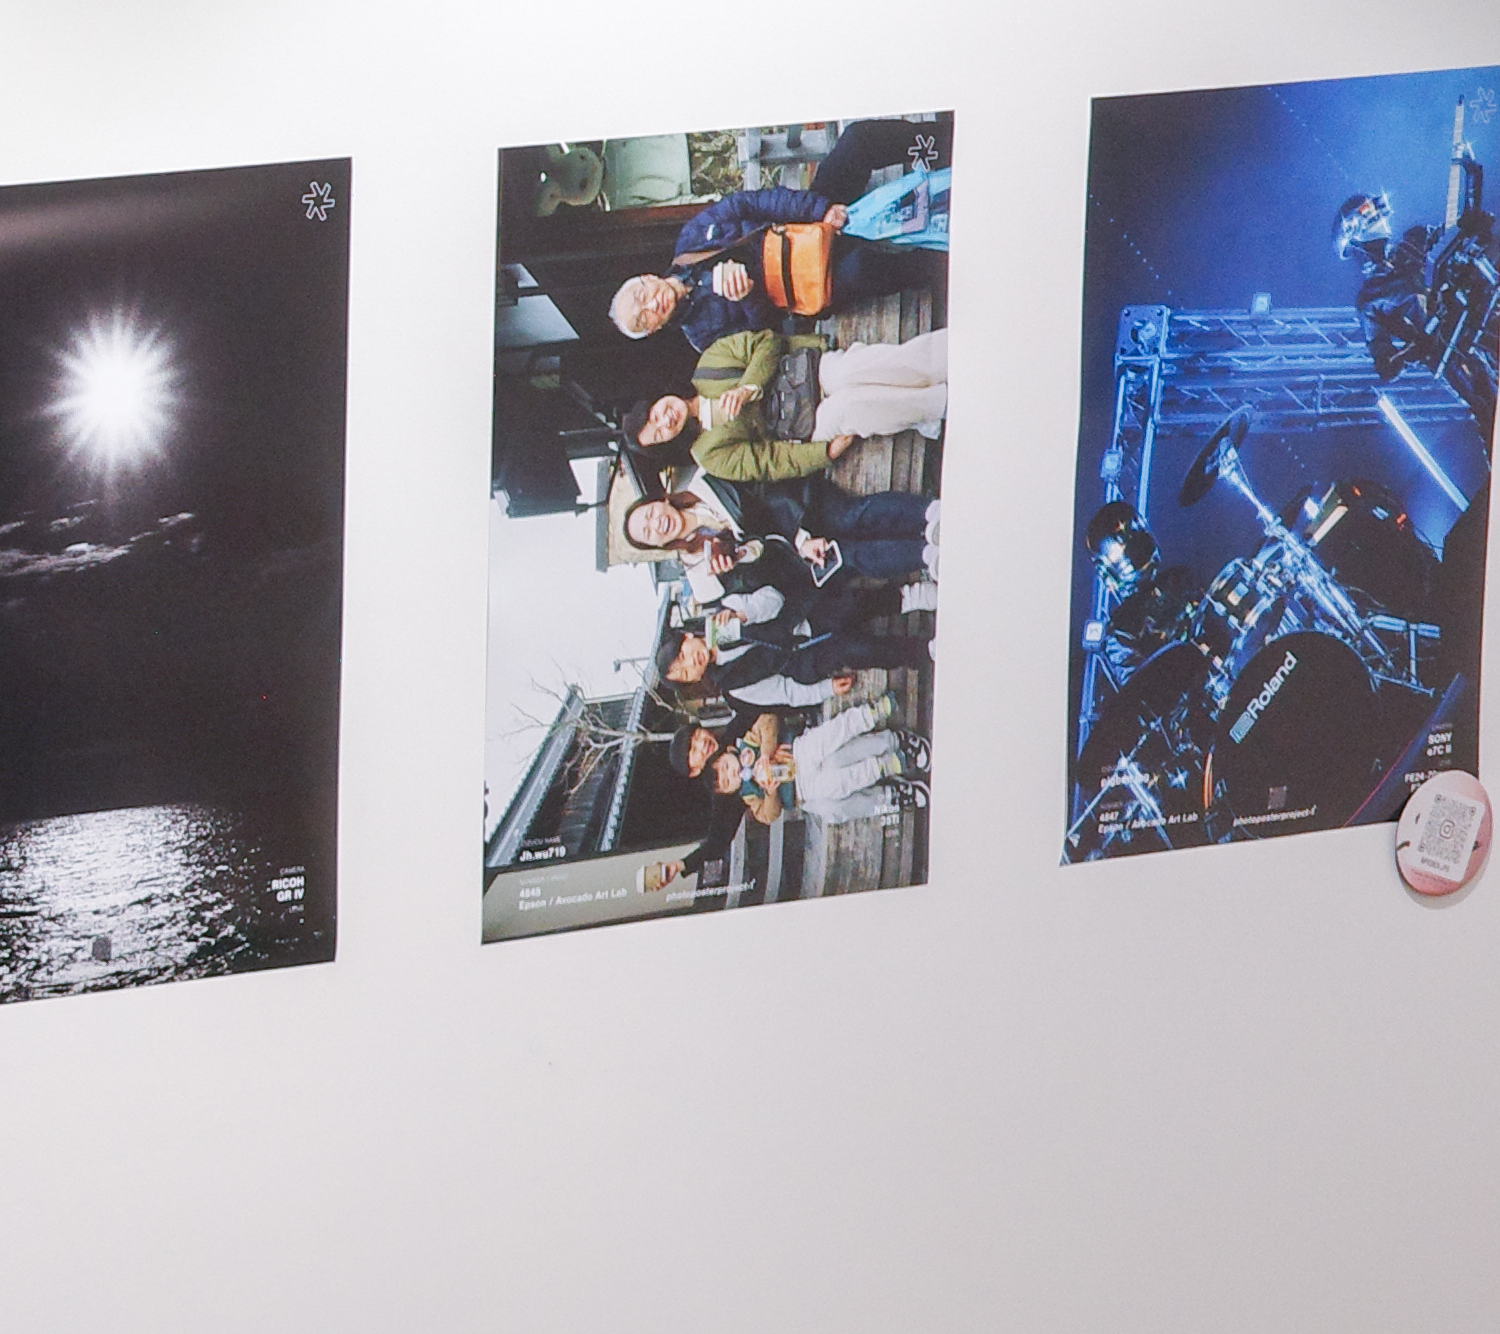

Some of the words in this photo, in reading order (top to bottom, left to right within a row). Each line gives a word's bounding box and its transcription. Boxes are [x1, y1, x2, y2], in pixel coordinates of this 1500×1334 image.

[1247, 650, 1298, 720] Roland
[1428, 732, 1452, 744] SONY
[1183, 811, 1198, 823] Lab
[271, 875, 305, 890] RICOH
[611, 887, 627, 898] Lab
